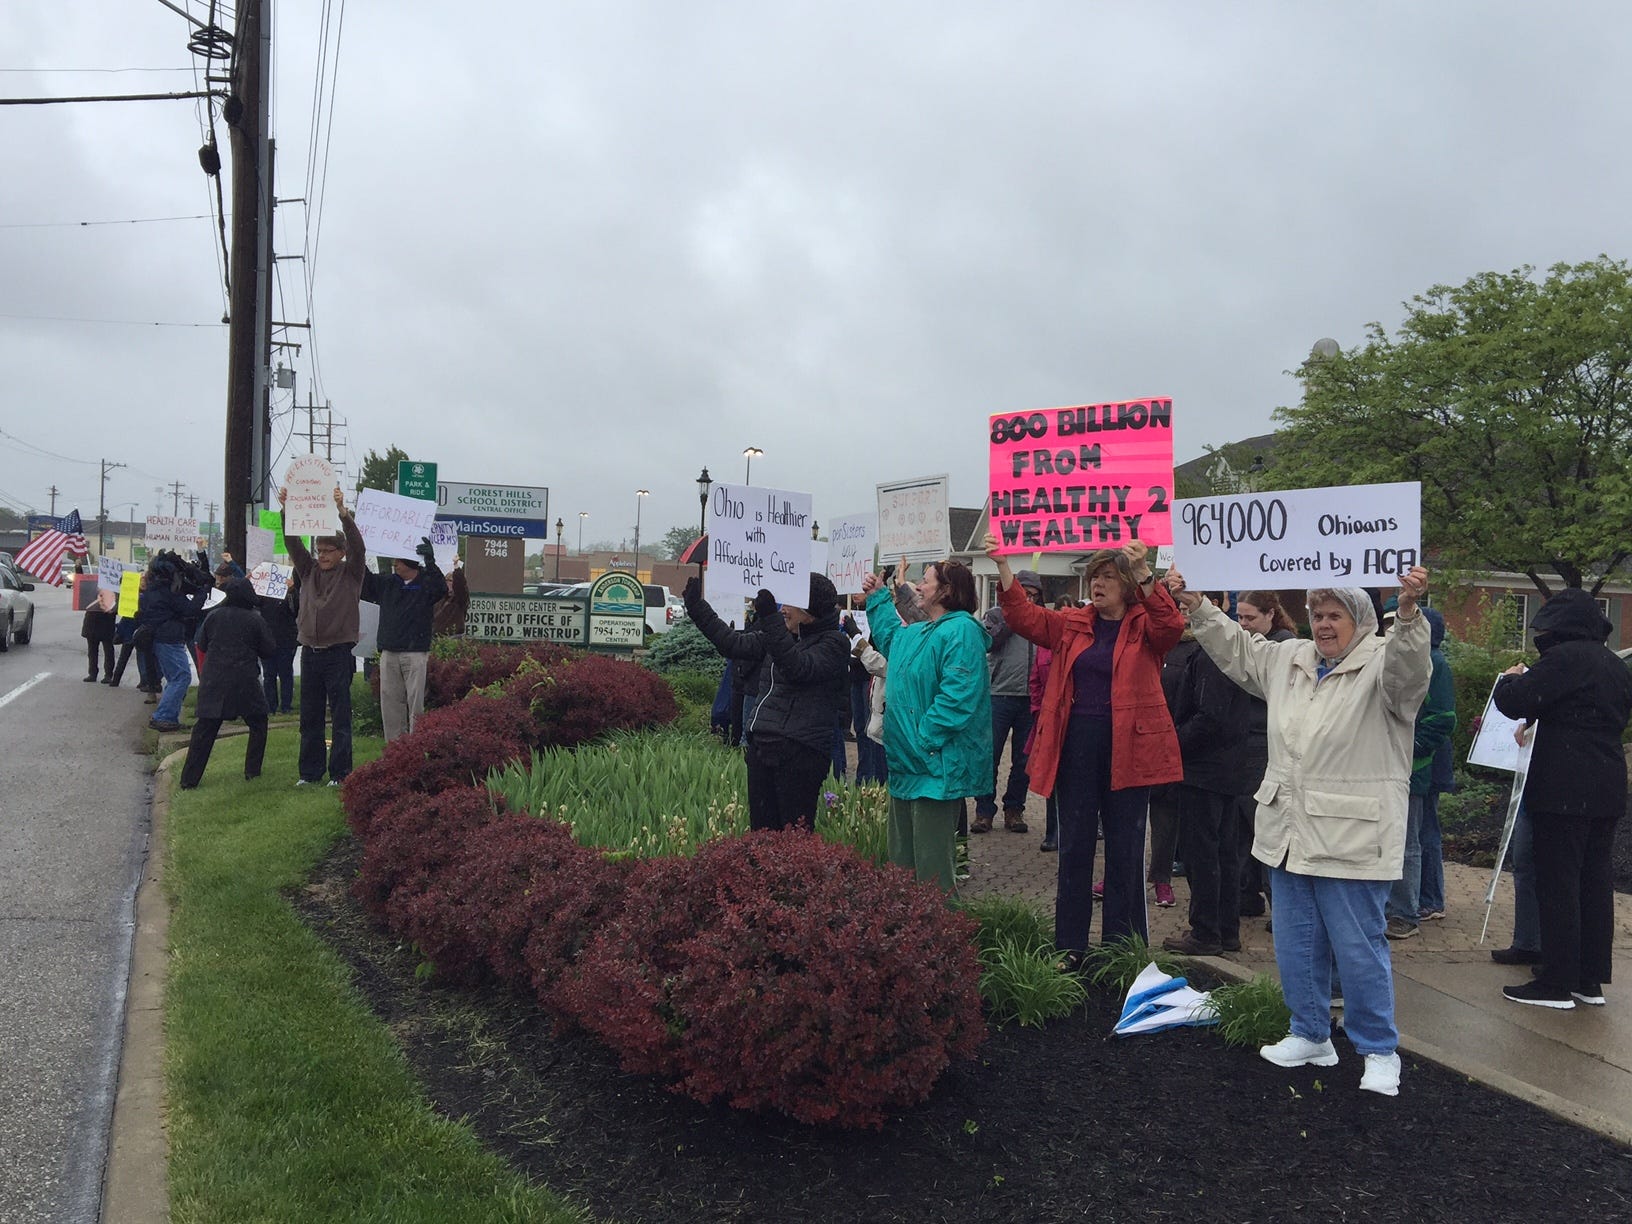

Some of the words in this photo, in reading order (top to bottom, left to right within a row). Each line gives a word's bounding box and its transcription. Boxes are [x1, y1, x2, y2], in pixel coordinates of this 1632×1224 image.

[990, 413, 1048, 444] 800
[1057, 401, 1171, 436] BILLION
[1012, 443, 1102, 478] FROM
[469, 488, 504, 498] FOREST
[506, 490, 532, 499] HILLS
[992, 485, 1132, 517] HEALTHY
[1148, 486, 1168, 512] 2
[458, 496, 498, 506] SCHOOL
[500, 498, 543, 508] DISTRICT
[714, 486, 744, 520] Ohio
[755, 510, 763, 522] is
[768, 495, 808, 528] Healthier
[146, 516, 174, 526] HEALTH
[177, 517, 196, 527] CARE
[359, 502, 433, 530] AFFORDABLE
[1182, 499, 1287, 549] 964,000
[1318, 514, 1398, 536] Ohioans
[292, 519, 332, 530] FATAL
[358, 523, 376, 538] ARE
[382, 529, 400, 542] FOR
[453, 520, 525, 535] MainSource
[999, 514, 1143, 547] WEALTHY
[484, 540, 508, 549] 7944
[746, 530, 766, 544] with
[484, 548, 508, 558] 7946
[714, 539, 764, 570] Affordable
[770, 551, 795, 575] Care
[1260, 552, 1320, 573] Covered
[1330, 552, 1351, 577] by
[1363, 548, 1416, 576] ACA
[744, 570, 764, 587] Act
[830, 558, 872, 587] SHAME
[468, 600, 498, 610] DERSON
[500, 601, 526, 611] SENIOR
[529, 602, 558, 612] CENTER
[517, 614, 554, 626] OFFICE
[560, 615, 572, 626] OF
[466, 625, 478, 636] EP
[484, 626, 514, 637] BRAD
[523, 627, 581, 640] WENSTRUP
[594, 627, 613, 637] 7954
[621, 627, 641, 637] 7970
